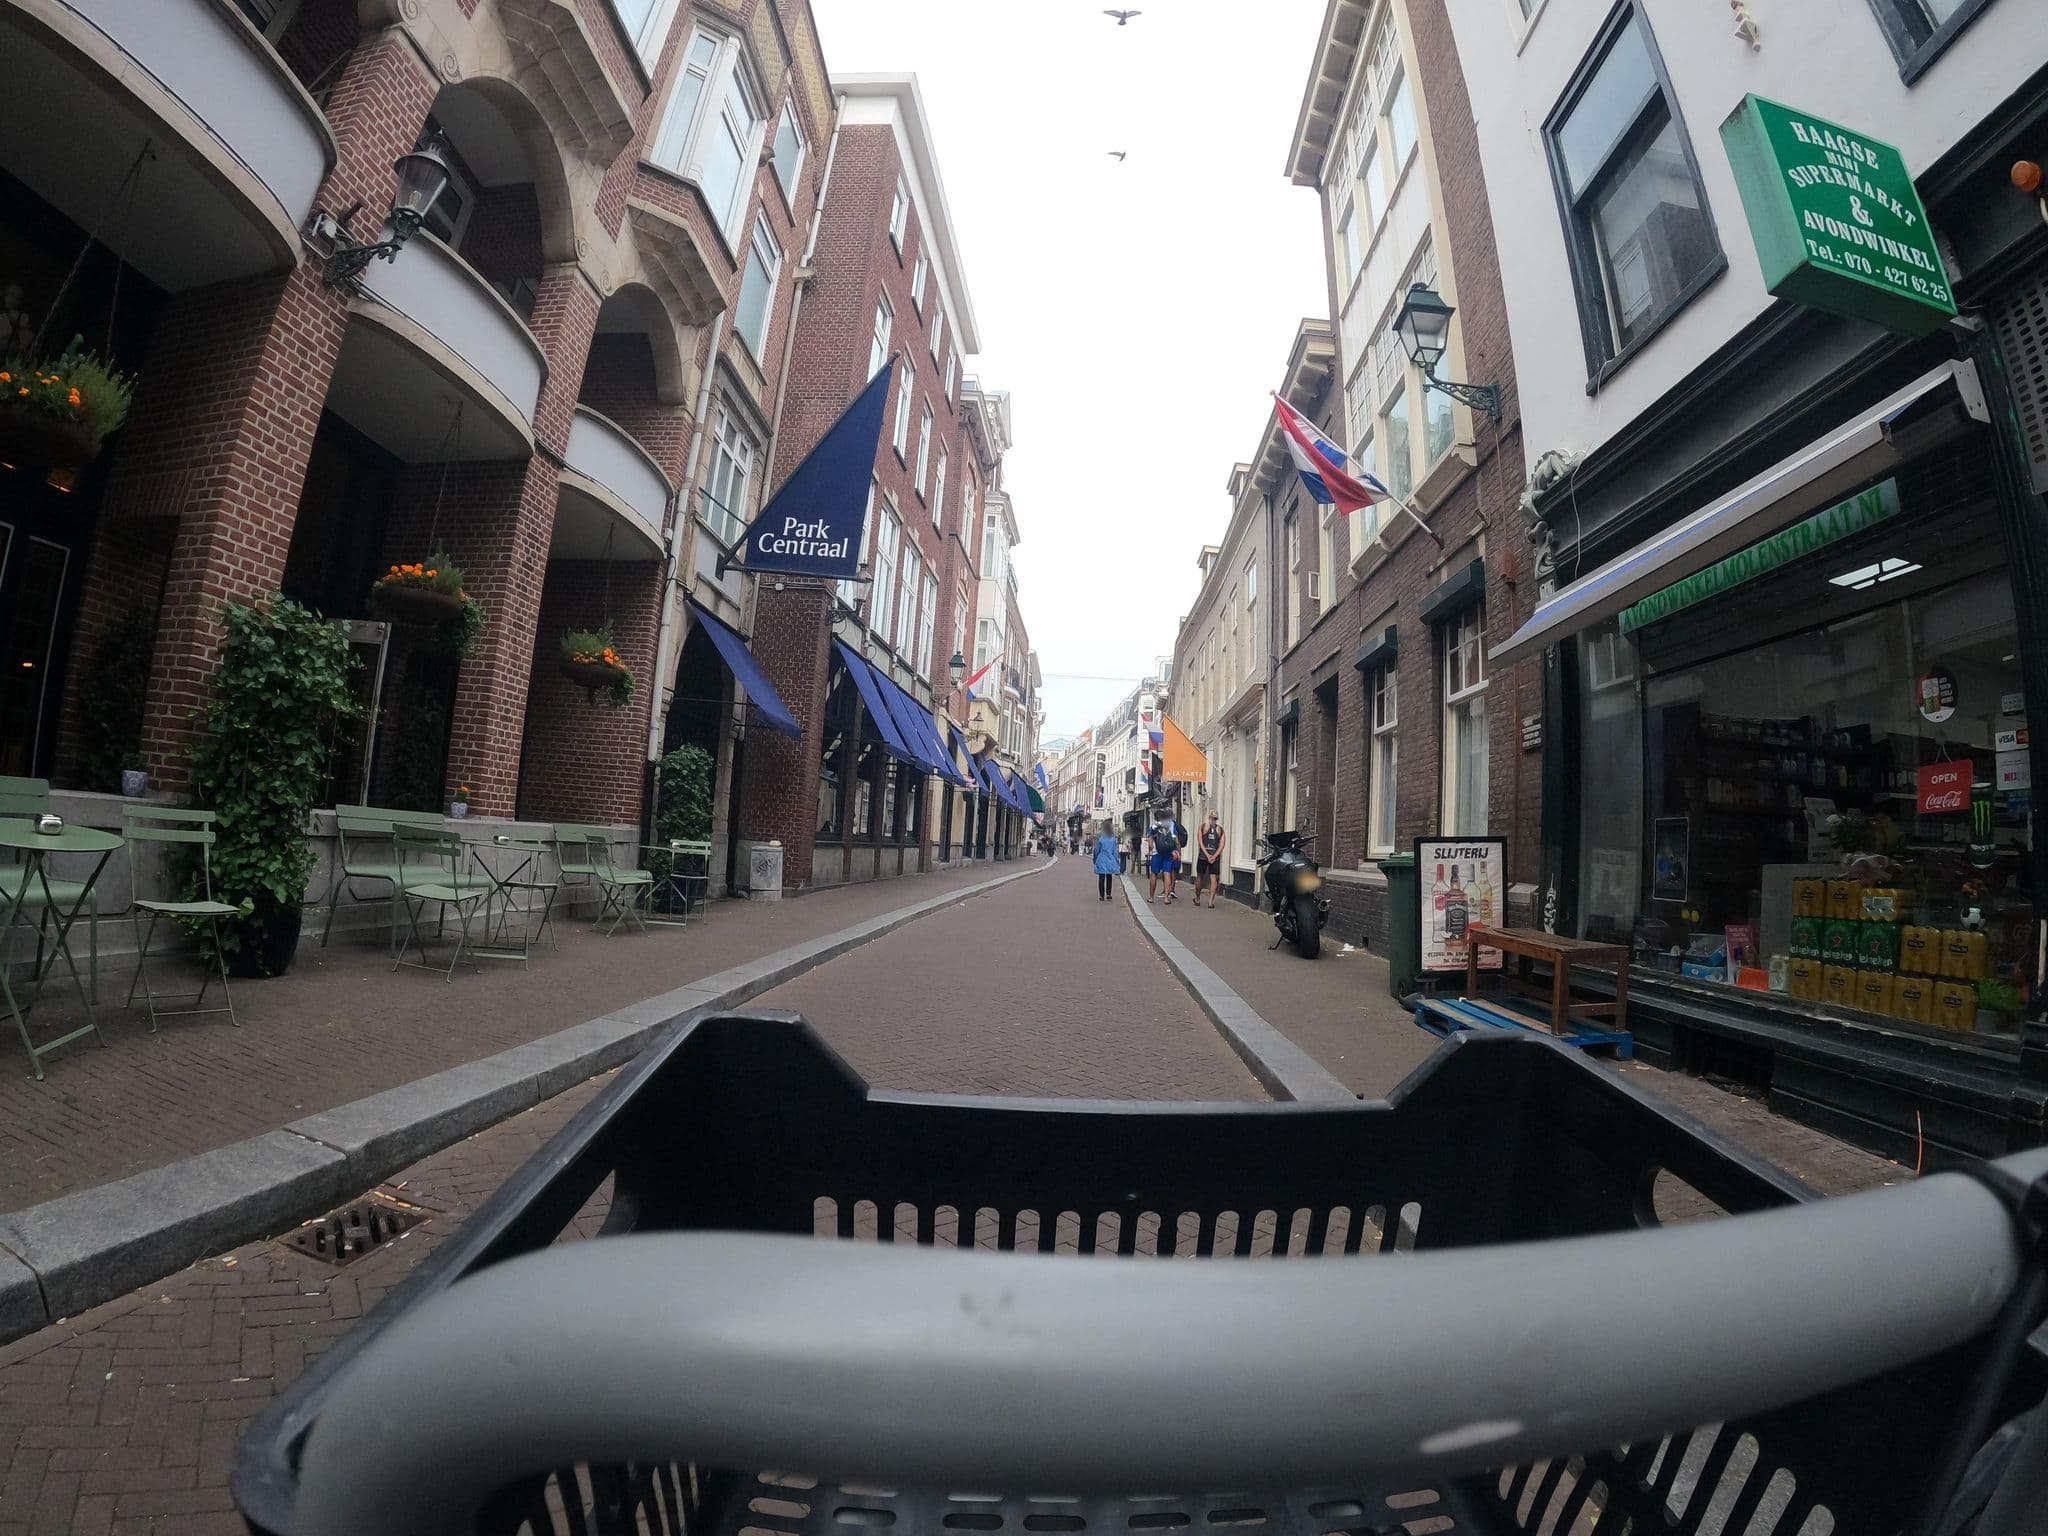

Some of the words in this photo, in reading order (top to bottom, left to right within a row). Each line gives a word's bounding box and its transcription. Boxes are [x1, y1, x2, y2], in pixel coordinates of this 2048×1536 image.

[1790, 121, 1879, 170] HAAGSE
[1825, 151, 1860, 173] MINI
[1788, 164, 1916, 227] SUPERMARKT
[1849, 195, 1873, 227] &
[1804, 210, 1935, 272] AVONDWINKEL
[1844, 251, 1872, 275] 070
[1884, 265, 1908, 287] 427
[1911, 275, 1930, 295] 62
[1930, 282, 1948, 302] 25
[783, 517, 830, 539] Park
[758, 533, 848, 558] Centraal
[1998, 733, 2015, 744] VISA
[1931, 772, 1958, 785] OPEN
[1434, 848, 1489, 859] SLIJTERIJ
